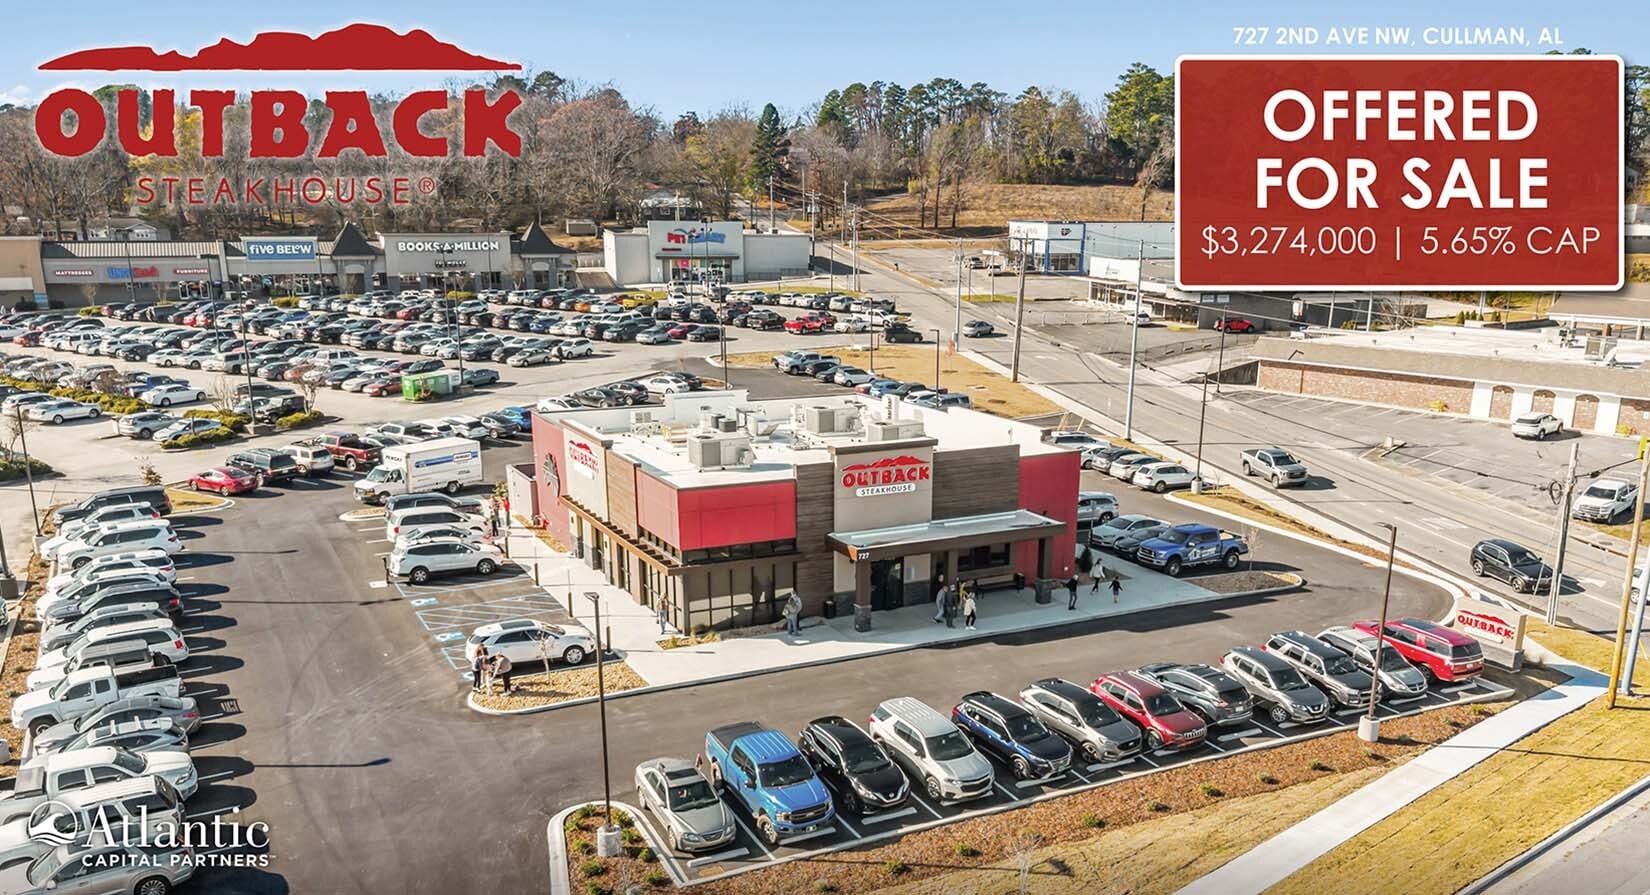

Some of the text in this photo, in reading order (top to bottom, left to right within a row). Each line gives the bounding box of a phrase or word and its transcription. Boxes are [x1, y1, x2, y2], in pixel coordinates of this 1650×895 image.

[249, 244, 274, 255] five
[842, 466, 930, 488] OUTBACK
[860, 484, 912, 495] STEAKHOUSE
[858, 552, 870, 560] 727
[1457, 614, 1514, 640] OUTBACK
